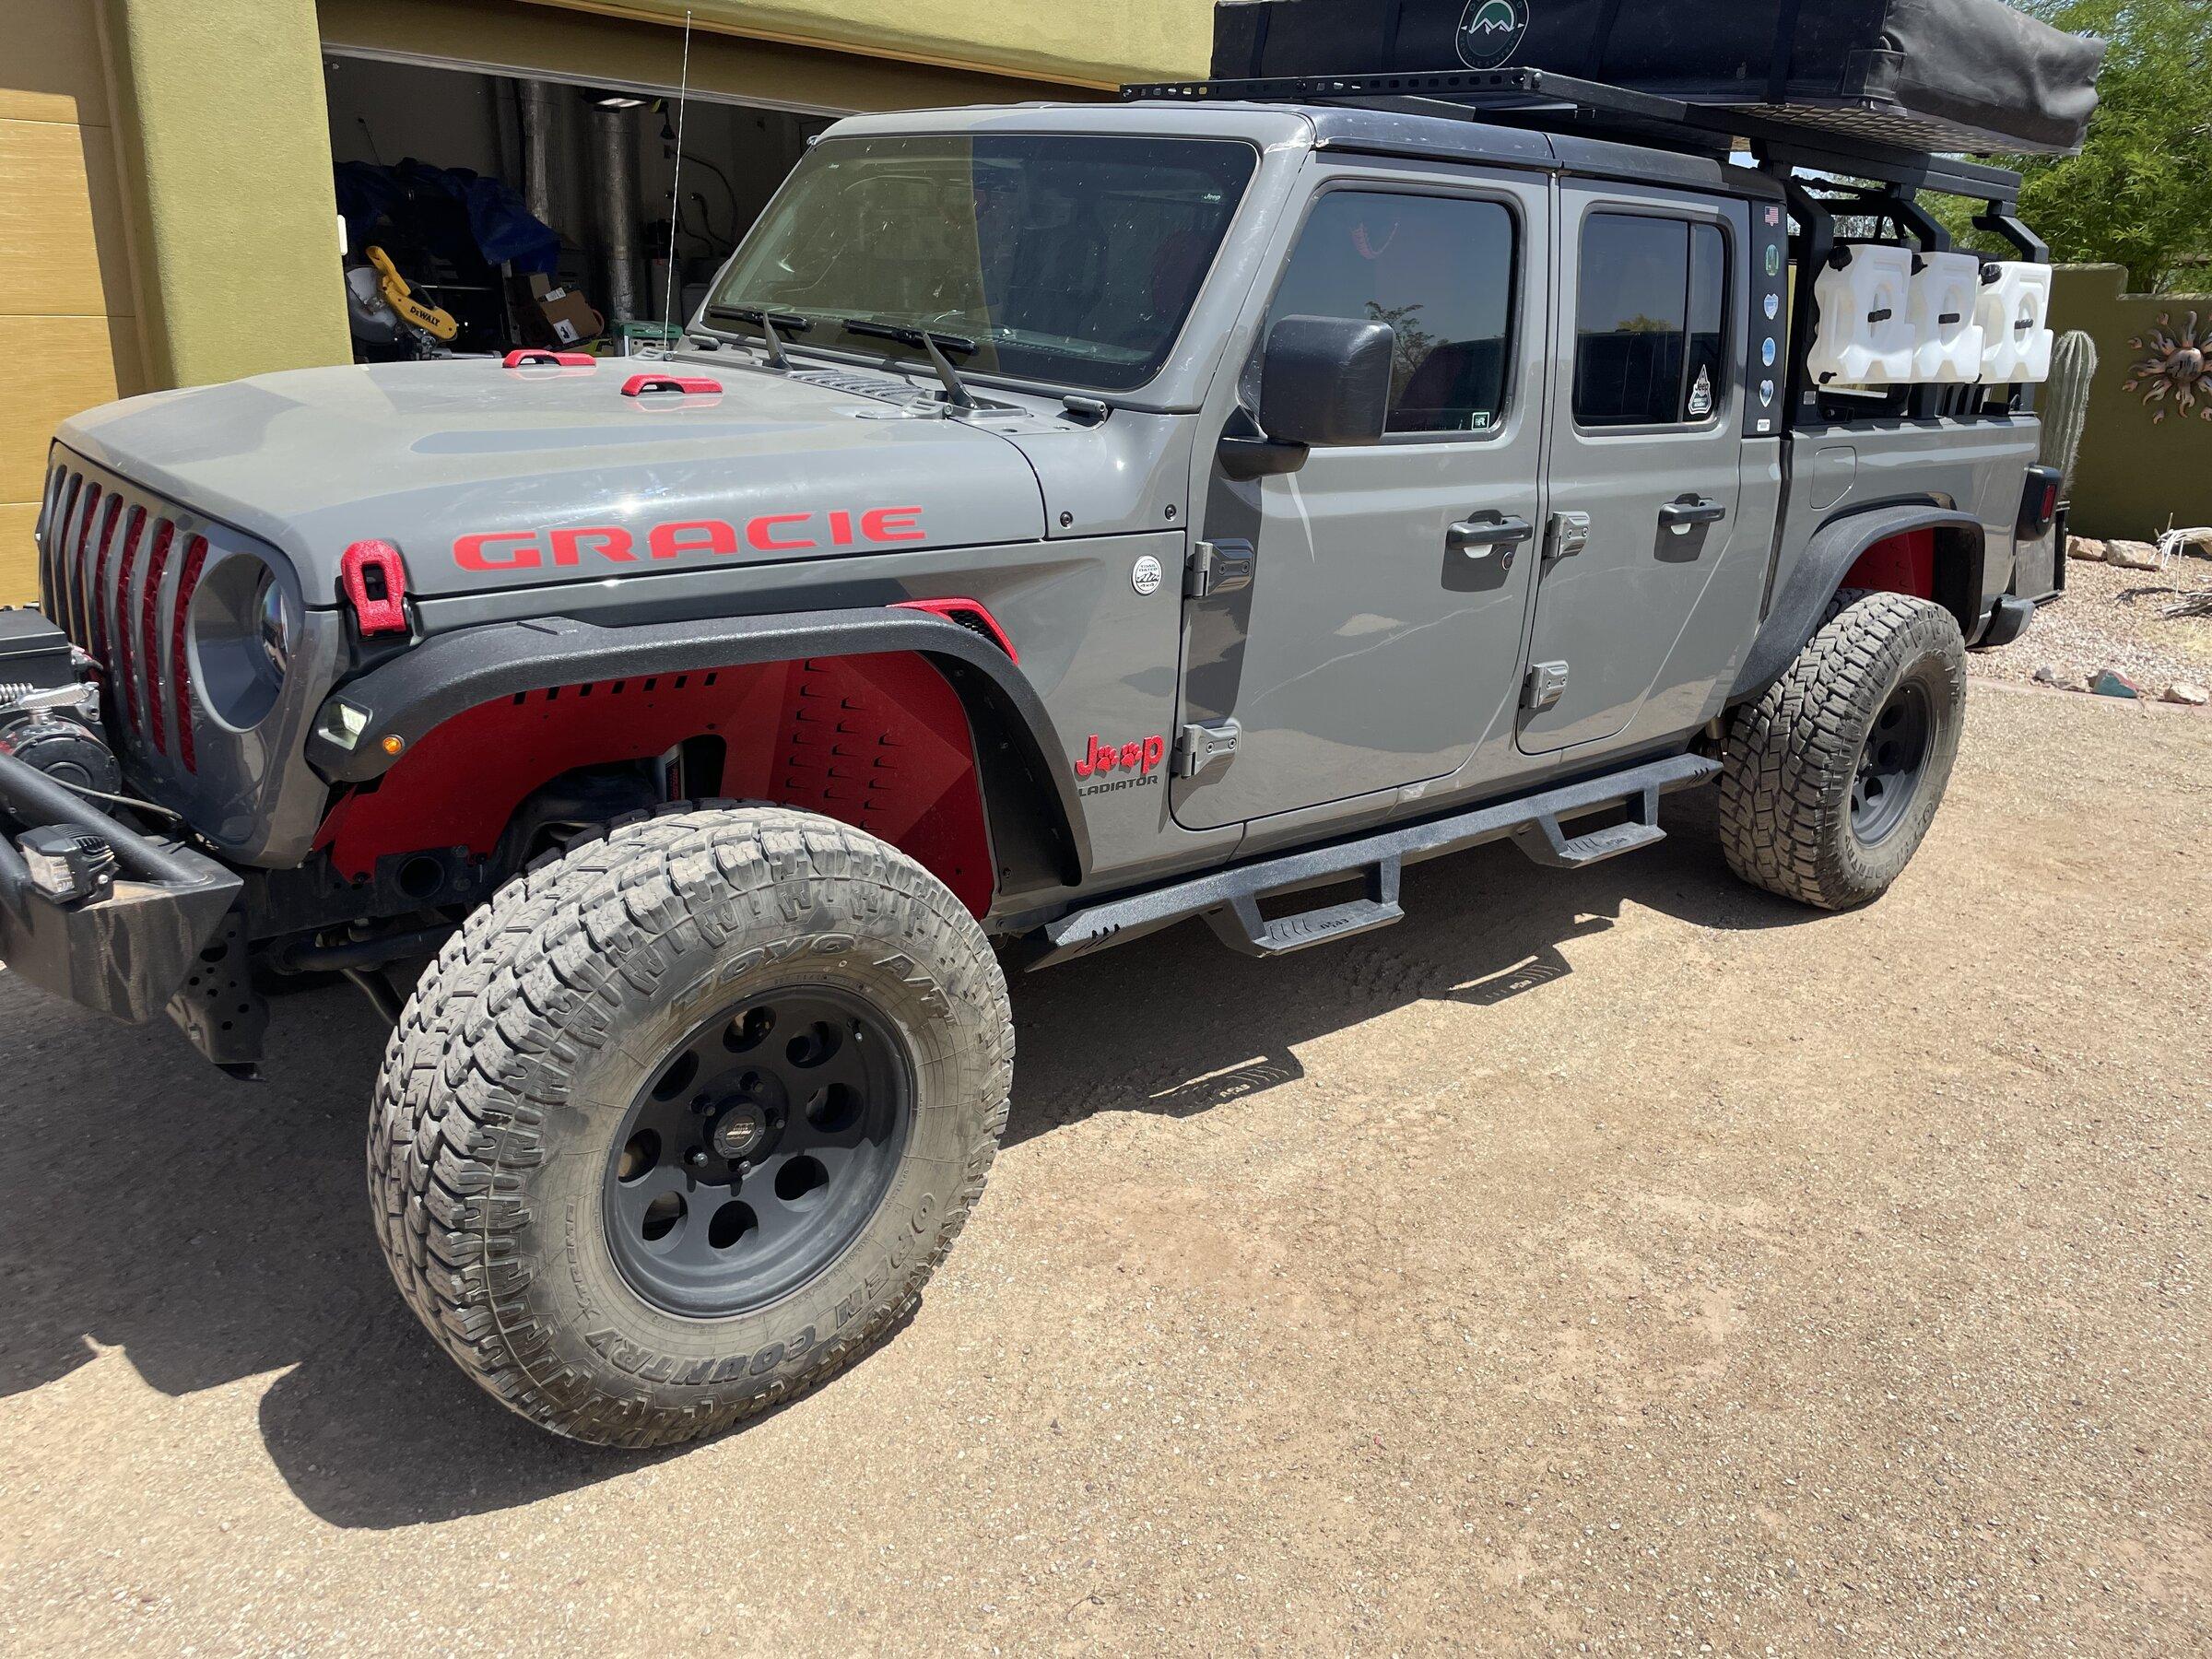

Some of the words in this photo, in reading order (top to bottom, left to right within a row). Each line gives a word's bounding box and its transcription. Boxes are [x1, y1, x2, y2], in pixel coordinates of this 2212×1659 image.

[453, 506, 925, 572] GRACIE
[1077, 775, 1159, 797] LADIATOR
[669, 933, 856, 1019] TOYO
[834, 1192, 936, 1330] OPEN
[585, 1324, 818, 1386] COUNTRY
